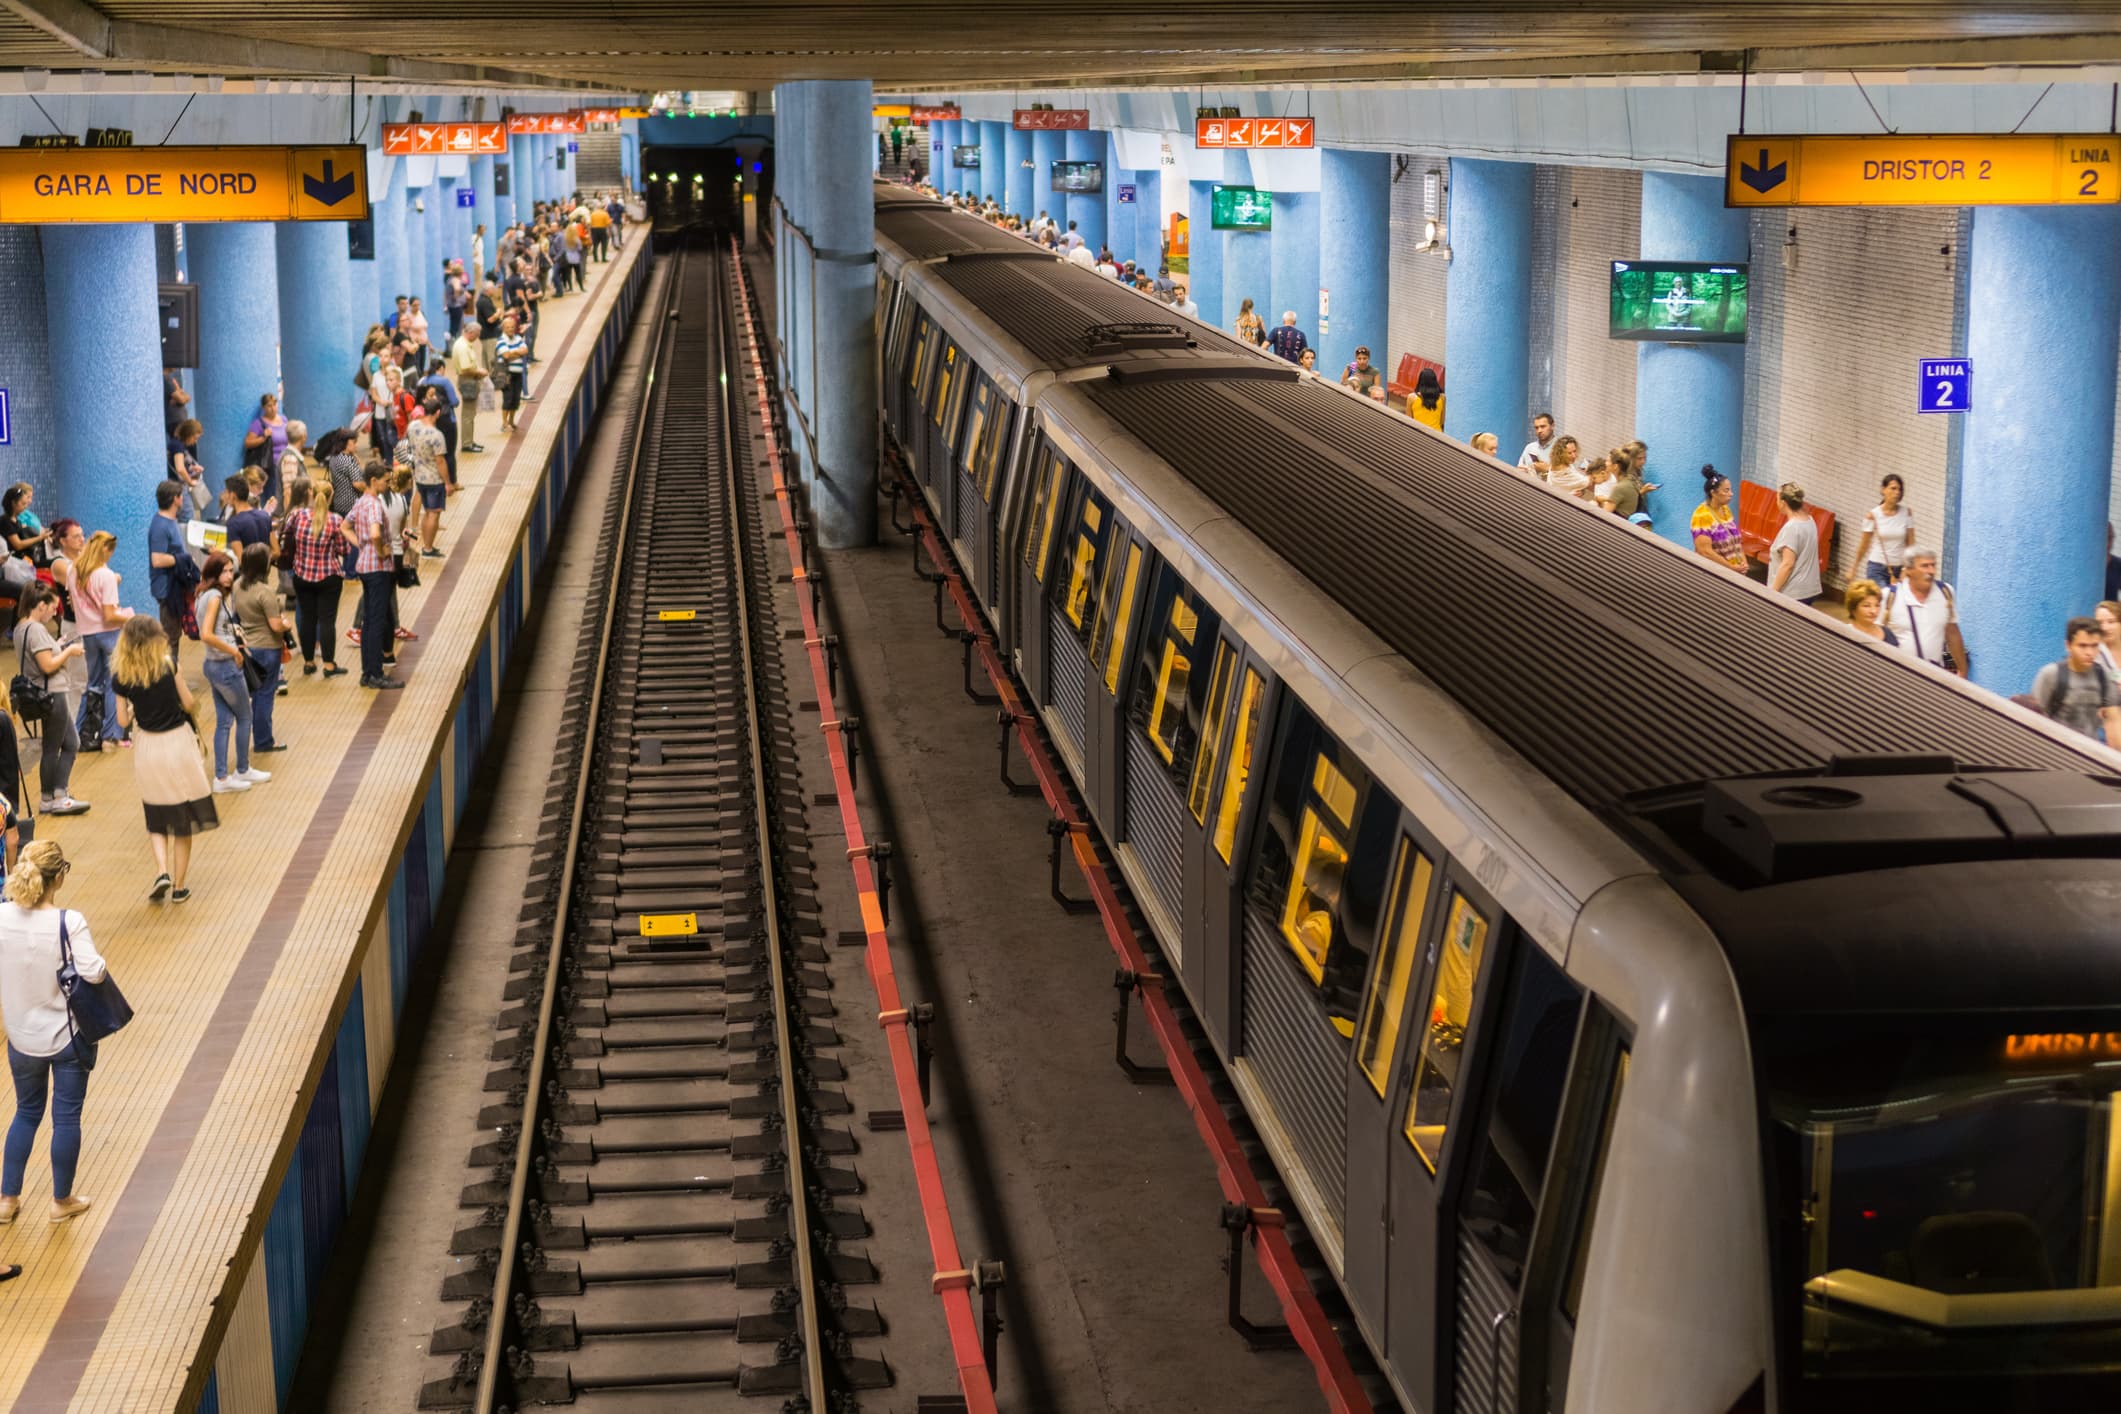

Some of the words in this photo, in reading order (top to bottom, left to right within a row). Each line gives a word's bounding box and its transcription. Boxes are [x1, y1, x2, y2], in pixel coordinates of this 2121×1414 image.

[2071, 149, 2111, 163] LINIA
[1863, 160, 1966, 180] DRISTOR
[1979, 160, 1992, 180] 2
[34, 174, 112, 196] GARA
[126, 174, 163, 195] DE
[179, 173, 257, 195] NORD
[2079, 169, 2099, 195] 2
[463, 195, 470, 206] 1
[1927, 365, 1965, 376] LINIA
[1936, 381, 1954, 406] 2
